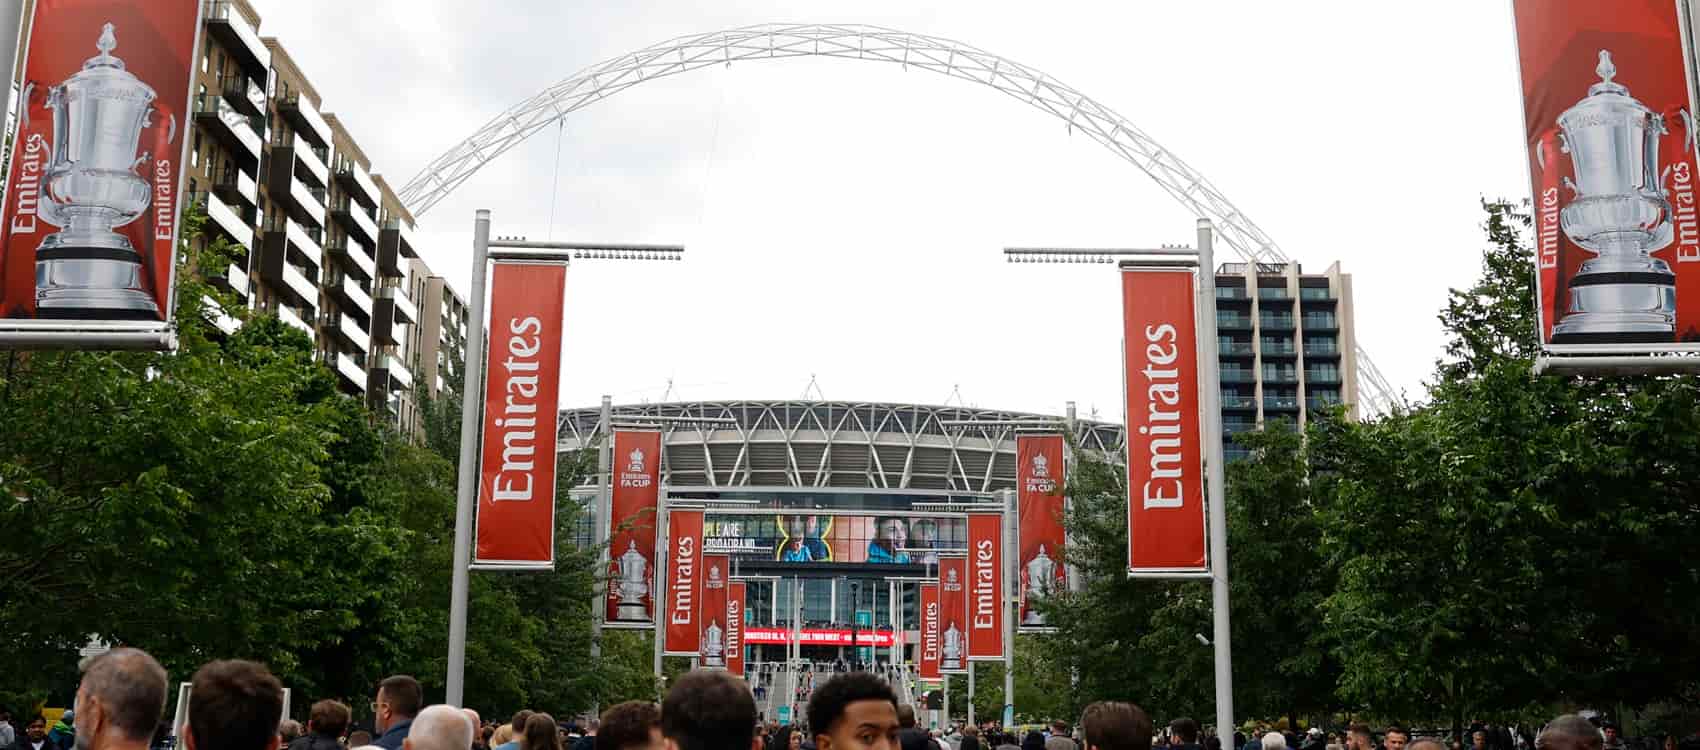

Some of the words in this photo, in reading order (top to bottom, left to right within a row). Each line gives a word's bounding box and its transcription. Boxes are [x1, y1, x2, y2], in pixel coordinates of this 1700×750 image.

[11, 133, 41, 235] Emirates
[153, 159, 172, 241] Emirates
[1673, 161, 1700, 264] Emirates
[1540, 187, 1558, 269] Emirates
[493, 316, 542, 502] Emirates
[1139, 323, 1184, 511] Emirates
[621, 480, 631, 488] FA
[632, 480, 651, 488] CUP
[722, 522, 740, 537] ARE
[672, 536, 693, 625] Emirates
[973, 539, 993, 630] Emirates
[727, 600, 738, 658] Emirates
[923, 602, 937, 661] Emirates
